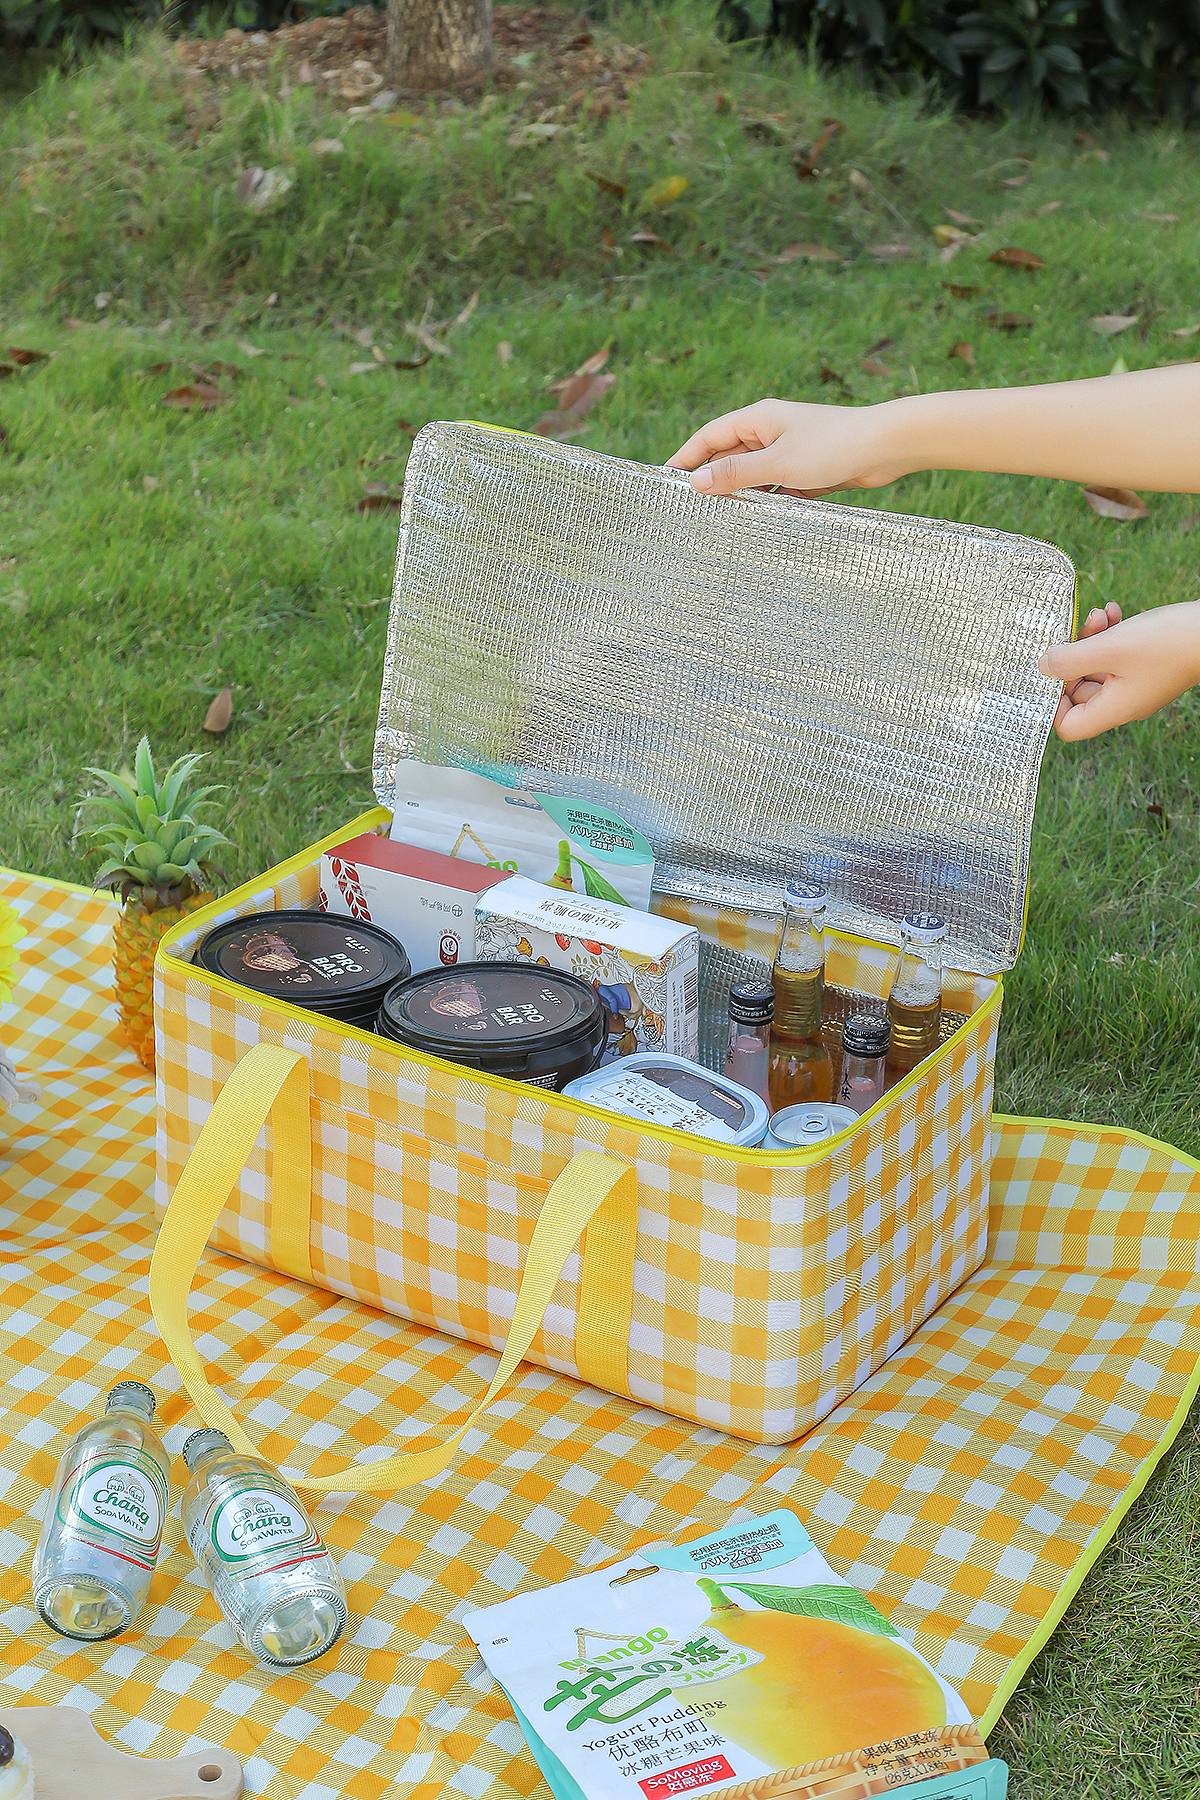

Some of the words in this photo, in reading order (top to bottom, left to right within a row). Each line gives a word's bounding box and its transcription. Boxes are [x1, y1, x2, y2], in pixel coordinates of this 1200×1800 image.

[311, 956, 345, 977] BAR
[329, 952, 363, 972] PRO
[495, 1006, 524, 1026] BAR
[515, 1003, 545, 1023] PRO
[93, 1489, 150, 1525] Chang
[231, 1516, 291, 1541] Chang
[558, 1627, 668, 1671] Mango
[671, 1652, 747, 1682] フルーツ
[582, 1722, 646, 1752] Yogurt
[649, 1700, 727, 1728] Pudding
[618, 1734, 727, 1778] 冰糖芒果味
[863, 1730, 941, 1760] 果味型果冻
[647, 1759, 723, 1790] SoMoving
